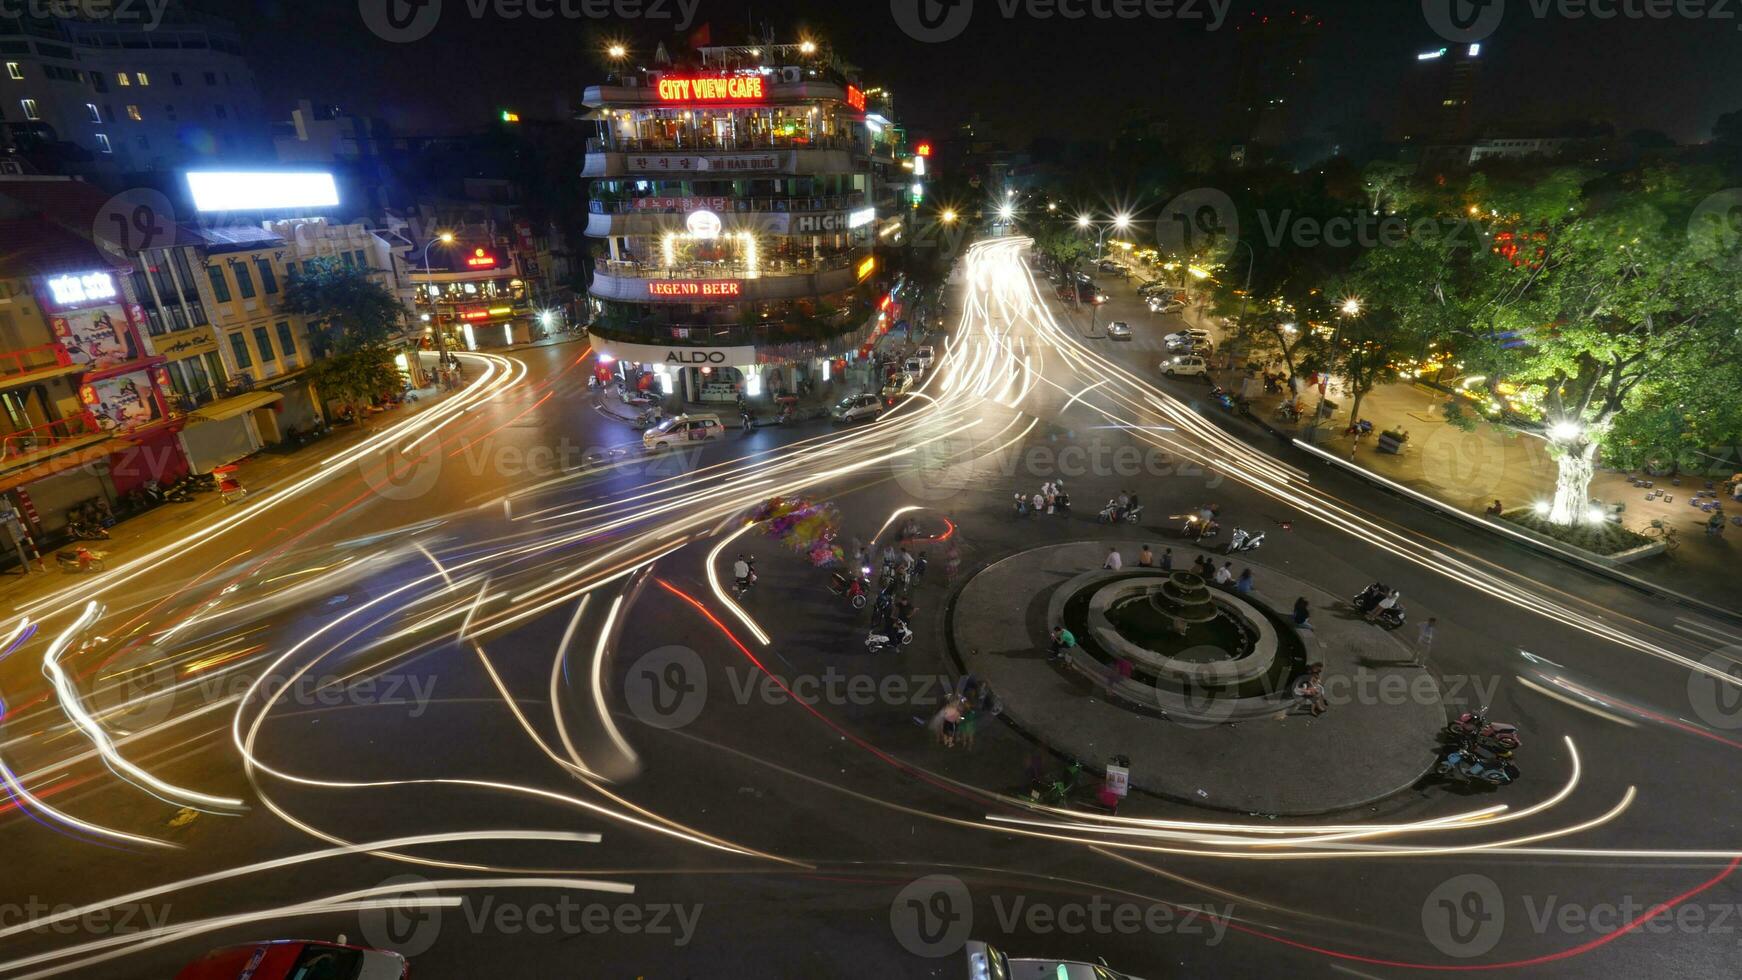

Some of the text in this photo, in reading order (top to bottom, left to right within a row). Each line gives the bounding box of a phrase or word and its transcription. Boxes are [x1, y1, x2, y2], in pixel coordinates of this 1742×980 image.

[659, 78, 762, 99] CITY VIEW CAFE
[649, 283, 739, 295] LEGEND BEER
[666, 351, 725, 364] ALDO
